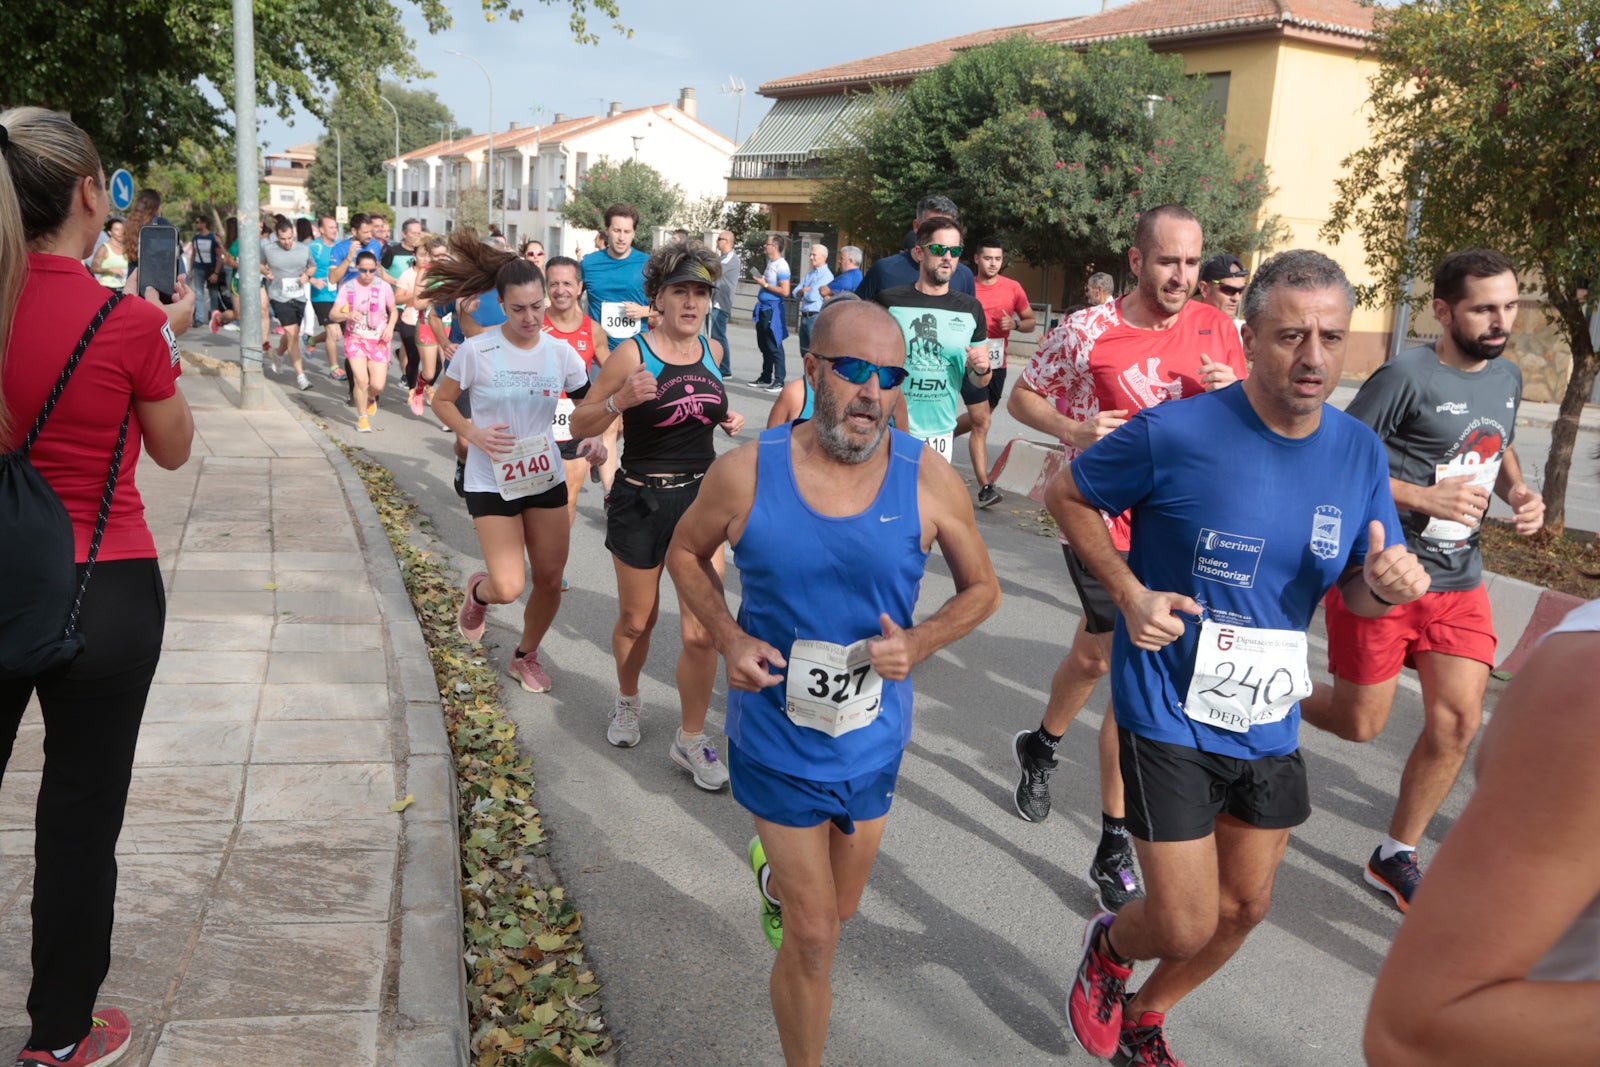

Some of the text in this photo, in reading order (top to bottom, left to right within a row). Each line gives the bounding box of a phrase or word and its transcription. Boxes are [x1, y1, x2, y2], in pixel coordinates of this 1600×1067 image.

[606, 316, 636, 328] 3066
[909, 377, 947, 391] HSN
[1443, 441, 1460, 457] The
[1458, 418, 1481, 441] world's
[501, 454, 550, 482] 2140
[1219, 540, 1261, 553] serinac
[1198, 556, 1229, 569] quiero
[1197, 563, 1251, 581] insonorizar
[807, 664, 871, 704] 327
[1198, 661, 1294, 706] 240
